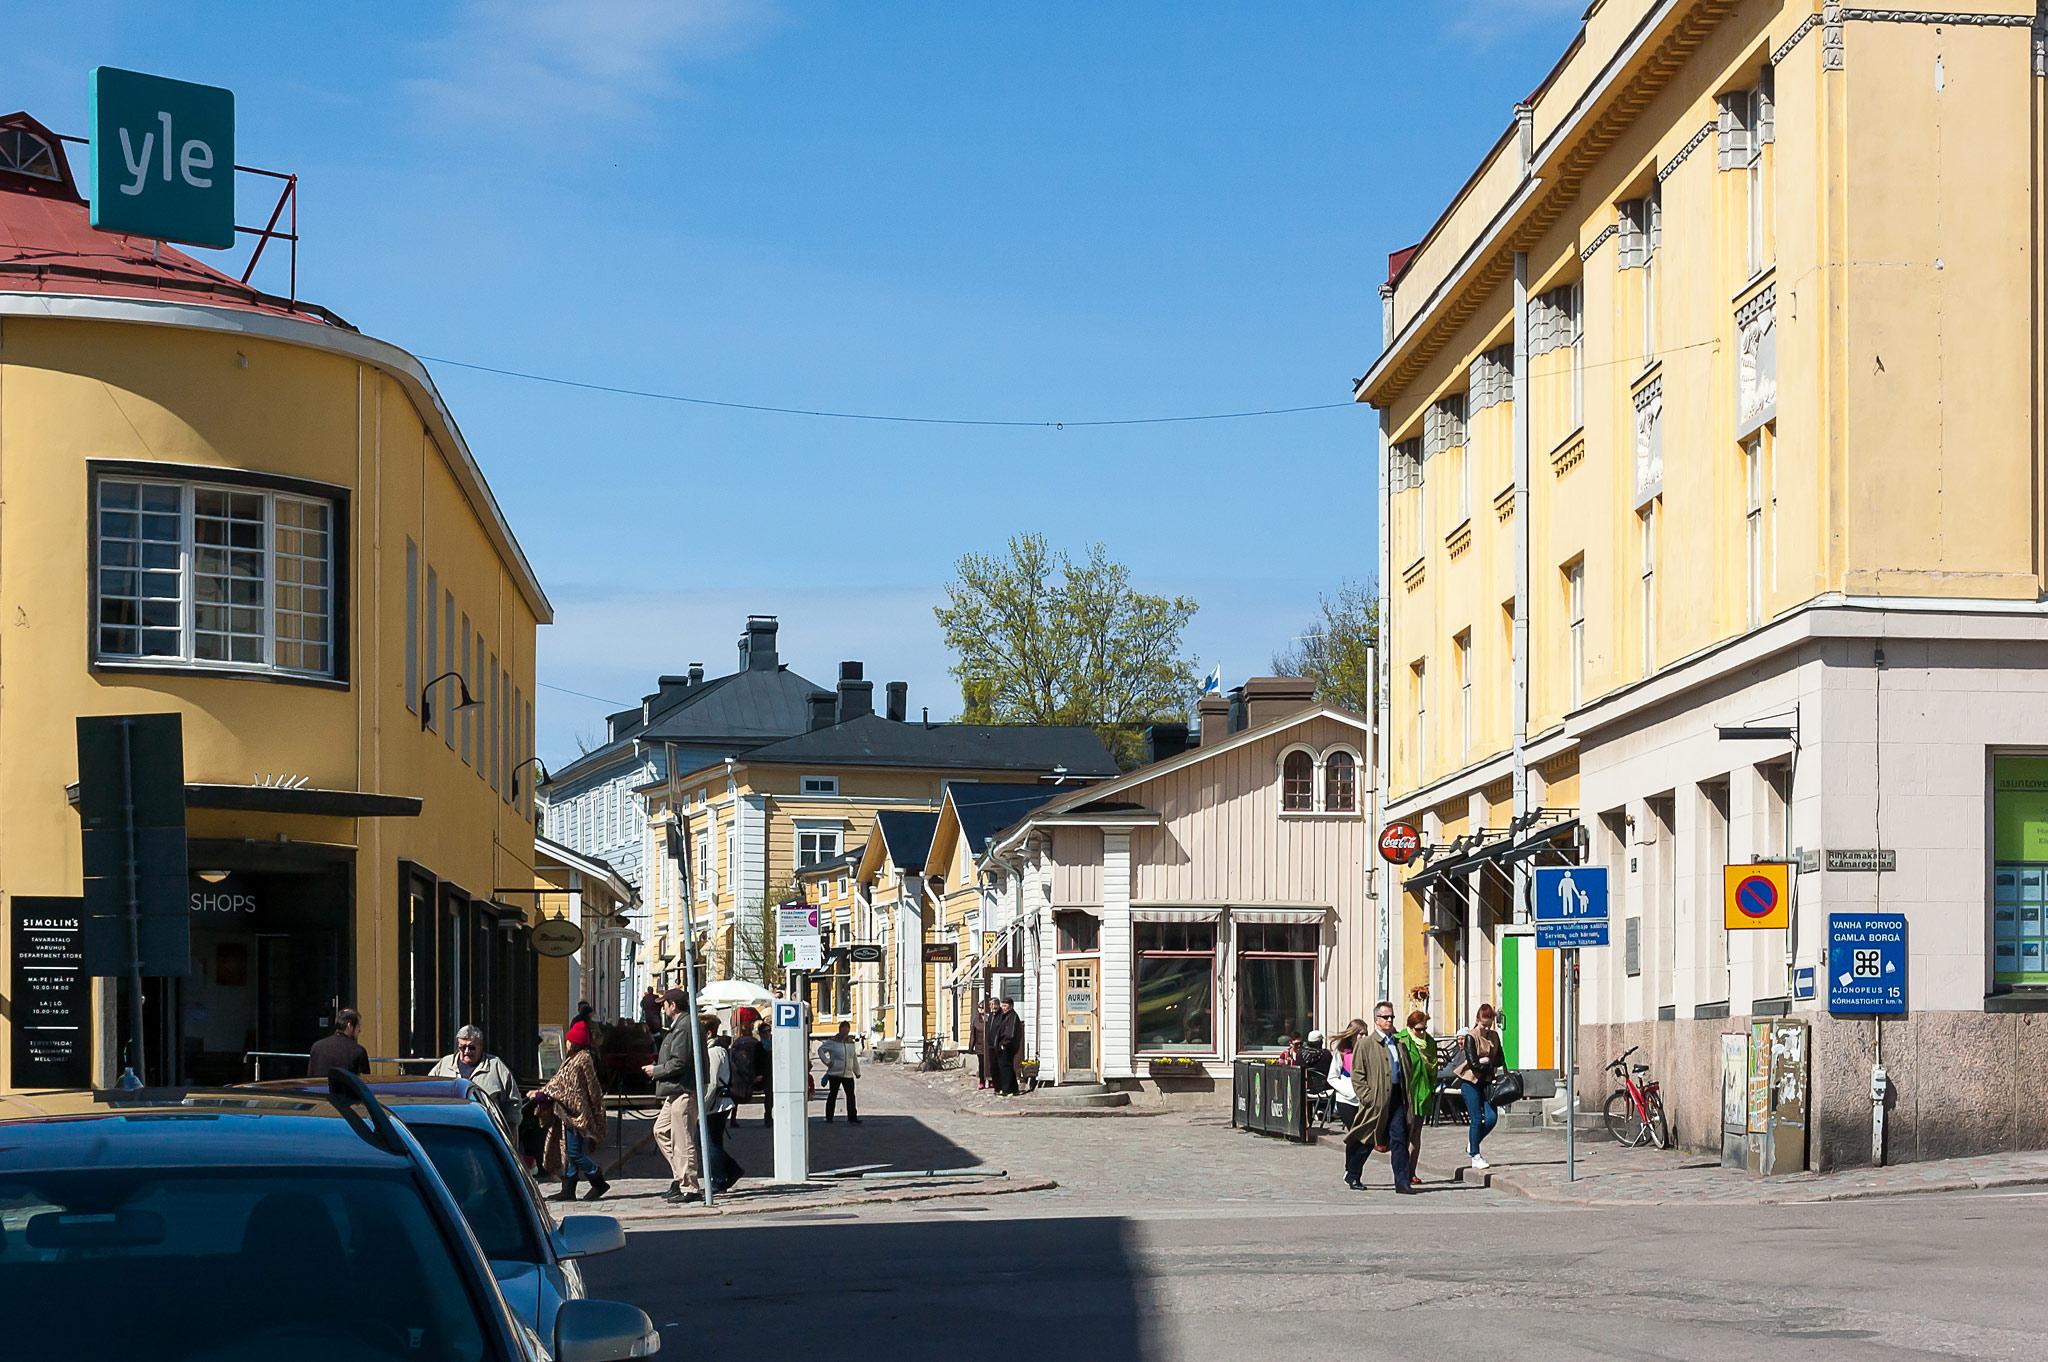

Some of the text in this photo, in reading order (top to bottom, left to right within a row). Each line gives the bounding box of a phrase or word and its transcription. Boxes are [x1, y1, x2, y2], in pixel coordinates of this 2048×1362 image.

[119, 111, 213, 196] yle
[1828, 851, 1887, 860] Rihkamakau
[1828, 859, 1892, 869] Krämaregaan
[190, 893, 256, 913] SHOPS
[23, 917, 79, 927] SIMOLIN'S
[1832, 921, 1903, 930] VANHA PORVOO
[1834, 933, 1901, 942] GAMLA BORGÅ
[1832, 986, 1901, 998] AJONOPEUS 15
[1068, 994, 1091, 1002] AURUM
[1831, 997, 1884, 1005] KÖRHASTIGHET
[780, 1005, 796, 1026] P
